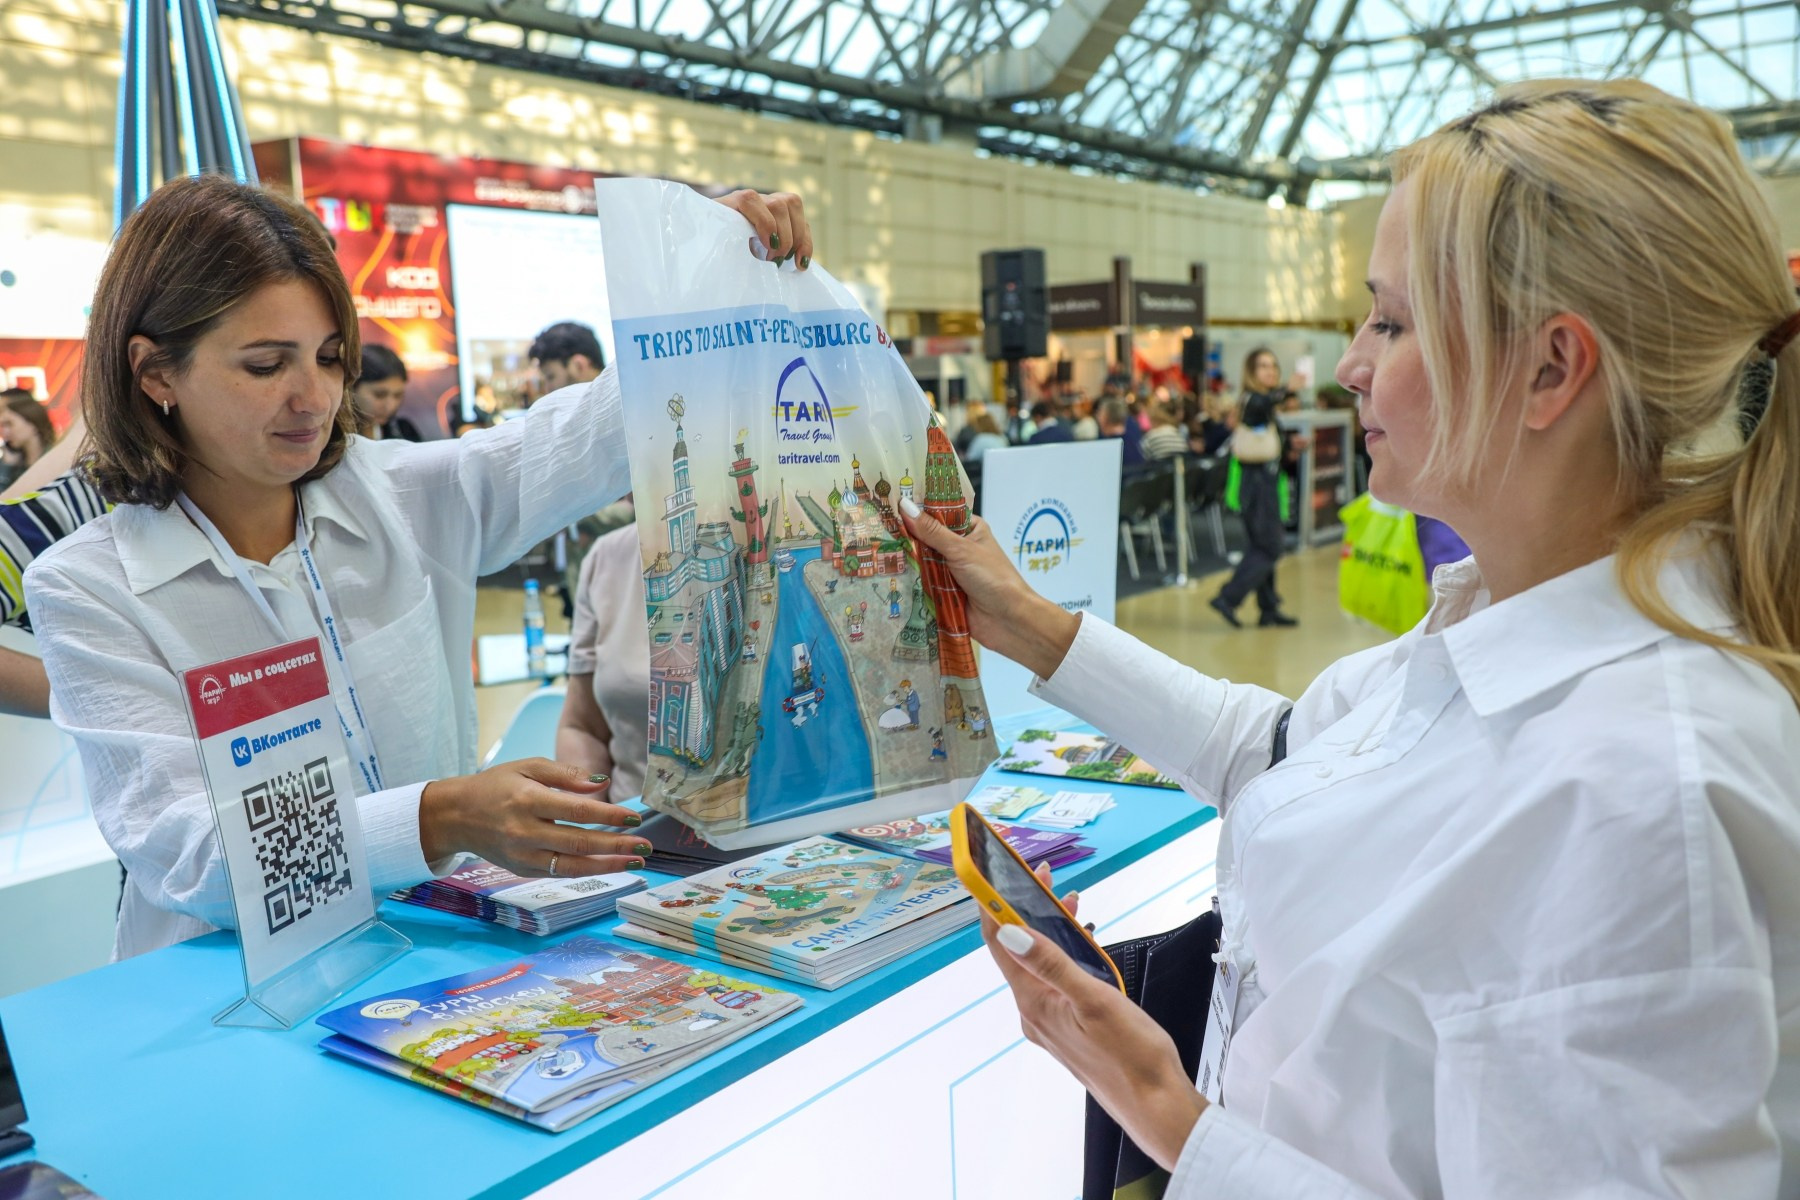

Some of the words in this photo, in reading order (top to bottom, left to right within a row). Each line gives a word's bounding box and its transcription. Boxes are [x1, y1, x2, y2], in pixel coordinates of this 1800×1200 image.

[633, 332, 693, 361] TRIPS
[695, 325, 711, 353] TO
[779, 428, 811, 442] Travel
[778, 450, 841, 465] taritravel.com
[1025, 537, 1066, 555] ТАРИ
[229, 671, 253, 688] Мы
[254, 668, 263, 681] в
[264, 651, 317, 677] соцсетях
[251, 718, 322, 754] ВКонтакте
[418, 993, 484, 1014] ТУРЫ
[453, 985, 547, 1017] МОСКВУ
